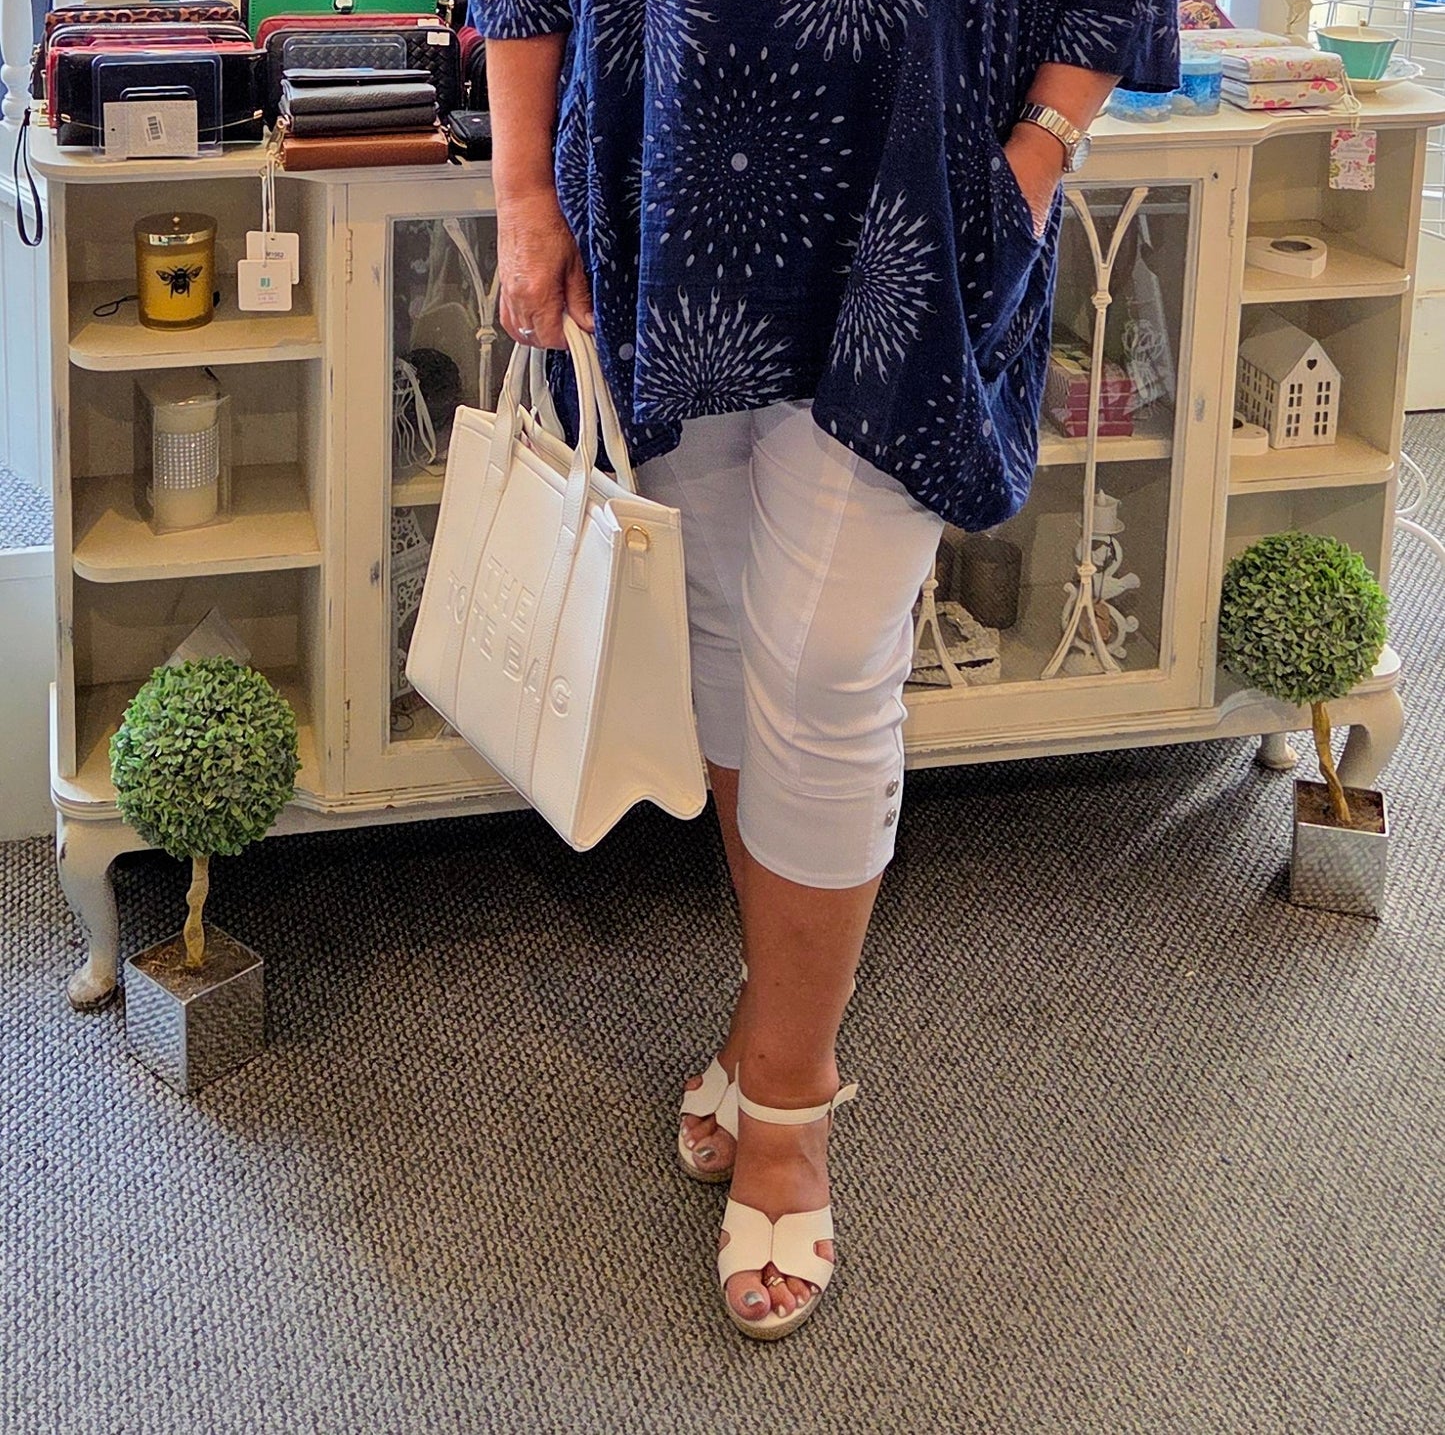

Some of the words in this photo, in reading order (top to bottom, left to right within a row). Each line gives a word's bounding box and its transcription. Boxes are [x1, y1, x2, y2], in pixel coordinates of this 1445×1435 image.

[446, 569, 498, 661] TOTE
[502, 636, 572, 718] BAG
[484, 554, 536, 634] THE
